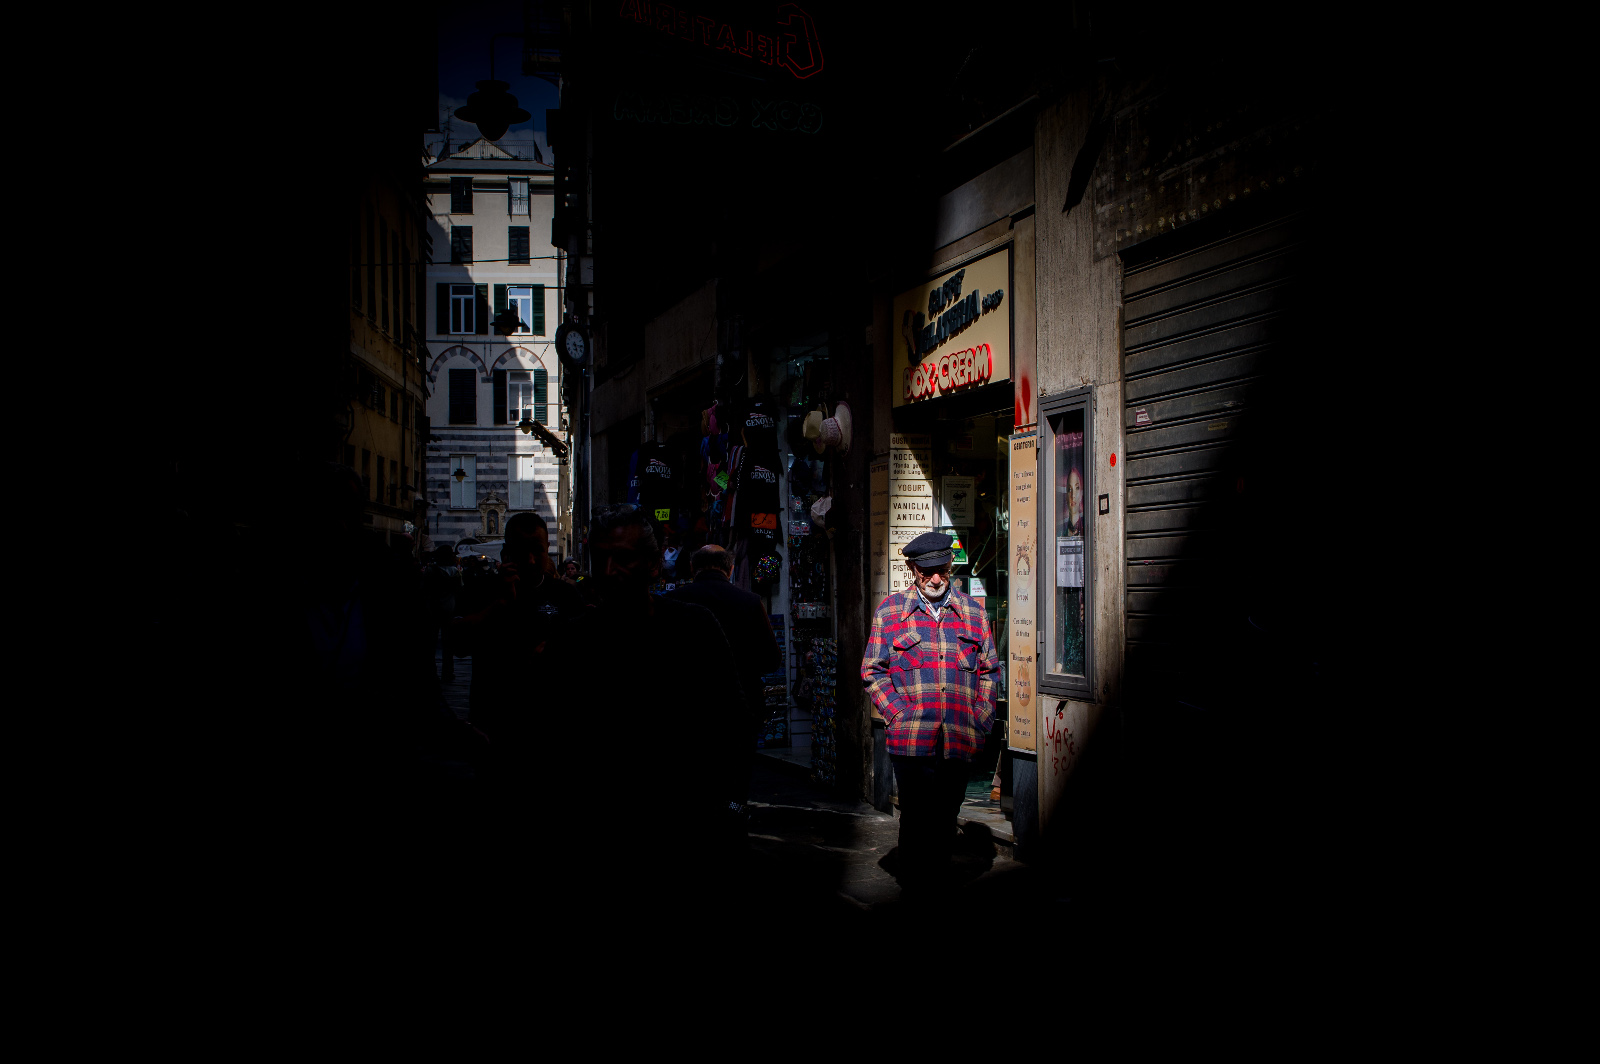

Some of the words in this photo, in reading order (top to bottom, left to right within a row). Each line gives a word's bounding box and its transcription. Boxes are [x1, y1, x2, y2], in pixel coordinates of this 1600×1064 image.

[745, 416, 775, 428] GENOVA
[893, 453, 929, 461] NOCCIOLA
[645, 465, 672, 475] GENOVA
[750, 471, 776, 481] GENOVA
[897, 484, 926, 492] YOGURT
[893, 502, 930, 511] VANIGLIA
[896, 513, 926, 521] ANTICA
